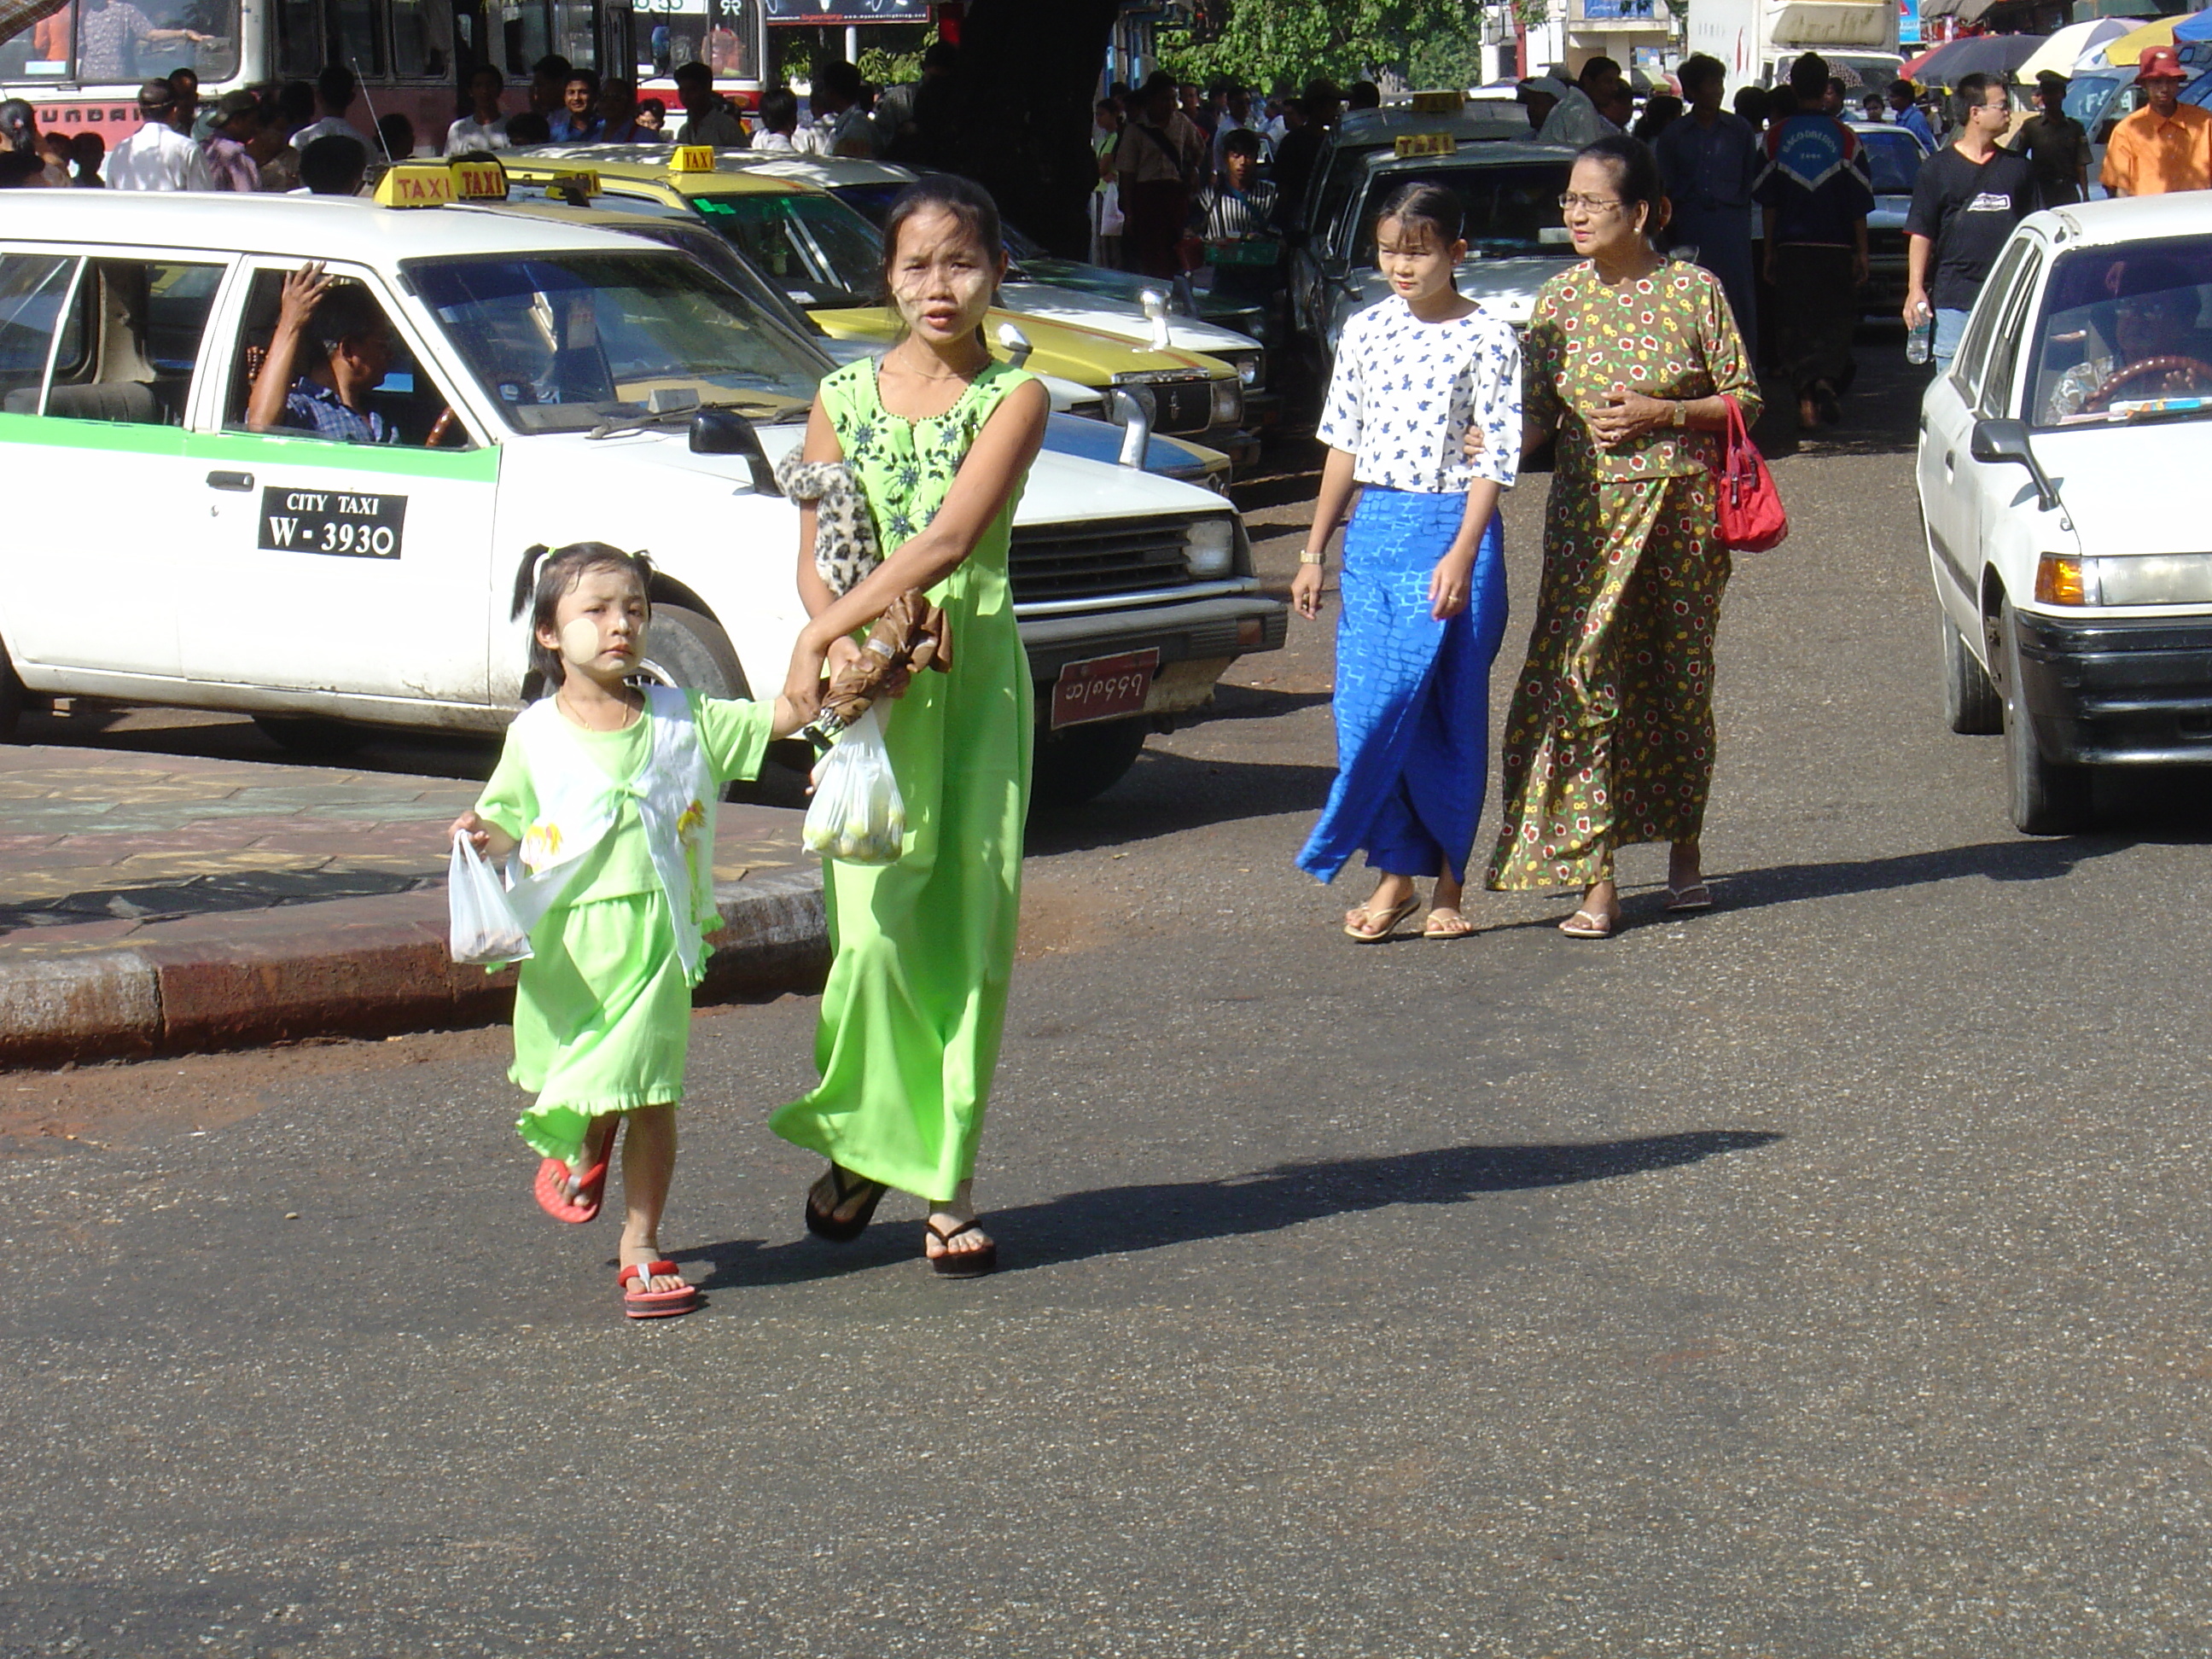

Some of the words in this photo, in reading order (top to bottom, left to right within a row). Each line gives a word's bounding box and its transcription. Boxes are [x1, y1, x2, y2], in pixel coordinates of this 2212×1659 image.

[1399, 137, 1450, 154] TAXI
[684, 152, 714, 168] TAXI
[397, 177, 451, 200] TAXI
[461, 171, 503, 195] TAXI
[286, 492, 329, 513] CITY
[337, 495, 379, 516] TAXI
